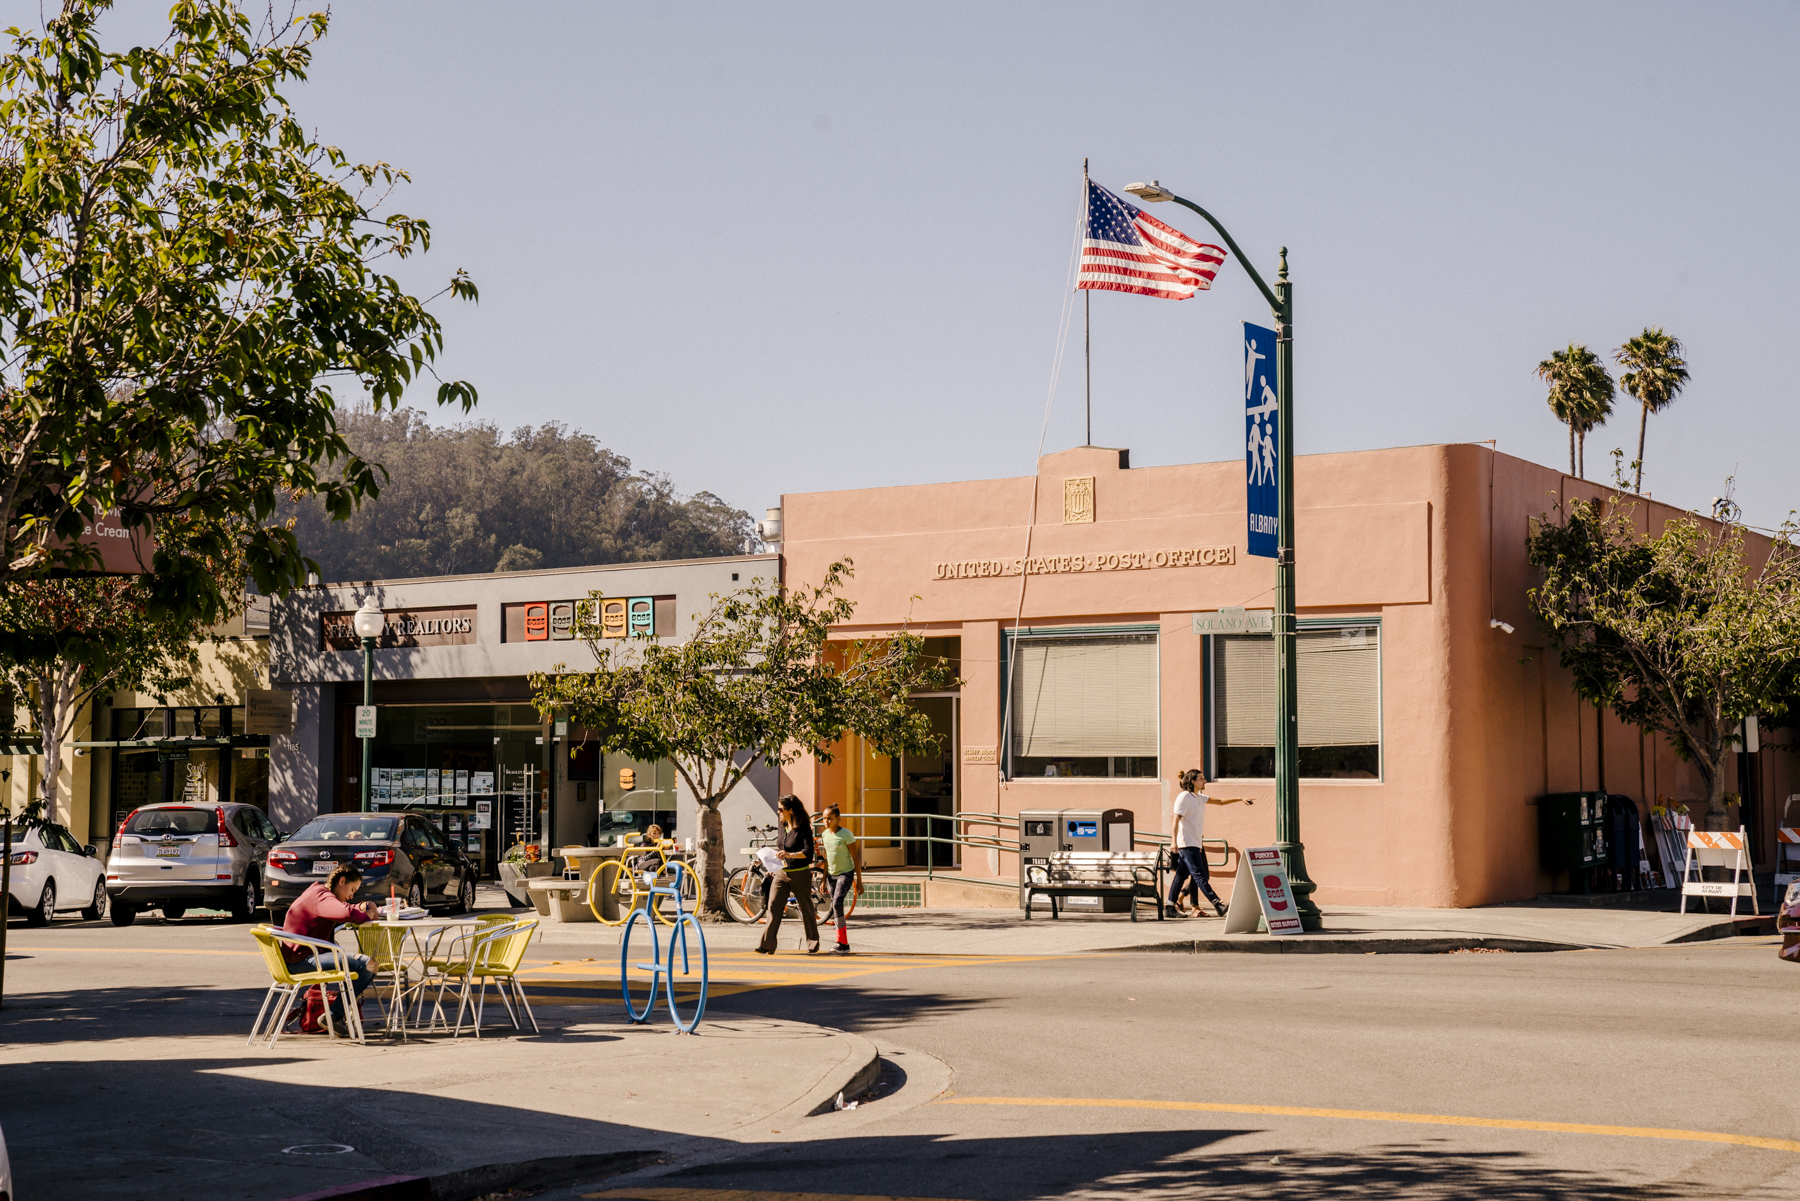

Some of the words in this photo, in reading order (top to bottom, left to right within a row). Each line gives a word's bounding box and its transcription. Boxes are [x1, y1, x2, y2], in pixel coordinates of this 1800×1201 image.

[1250, 513, 1278, 535] ALBANY
[96, 522, 132, 538] Cream
[935, 560, 1003, 579] UNITED
[1013, 556, 1085, 576] STATES
[1094, 552, 1145, 570] POST
[1154, 547, 1231, 566] OFFICE
[527, 617, 545, 626] BOSS
[553, 616, 571, 625] BOSS
[605, 614, 624, 623] BOSS
[632, 613, 651, 622] BOSS
[330, 622, 395, 638] FEAY
[397, 617, 471, 636] REALTORS
[1196, 618, 1242, 631] SOLANO
[362, 709, 371, 717] 20
[1254, 851, 1275, 859] PARKING
[1266, 889, 1285, 898] BOSS
